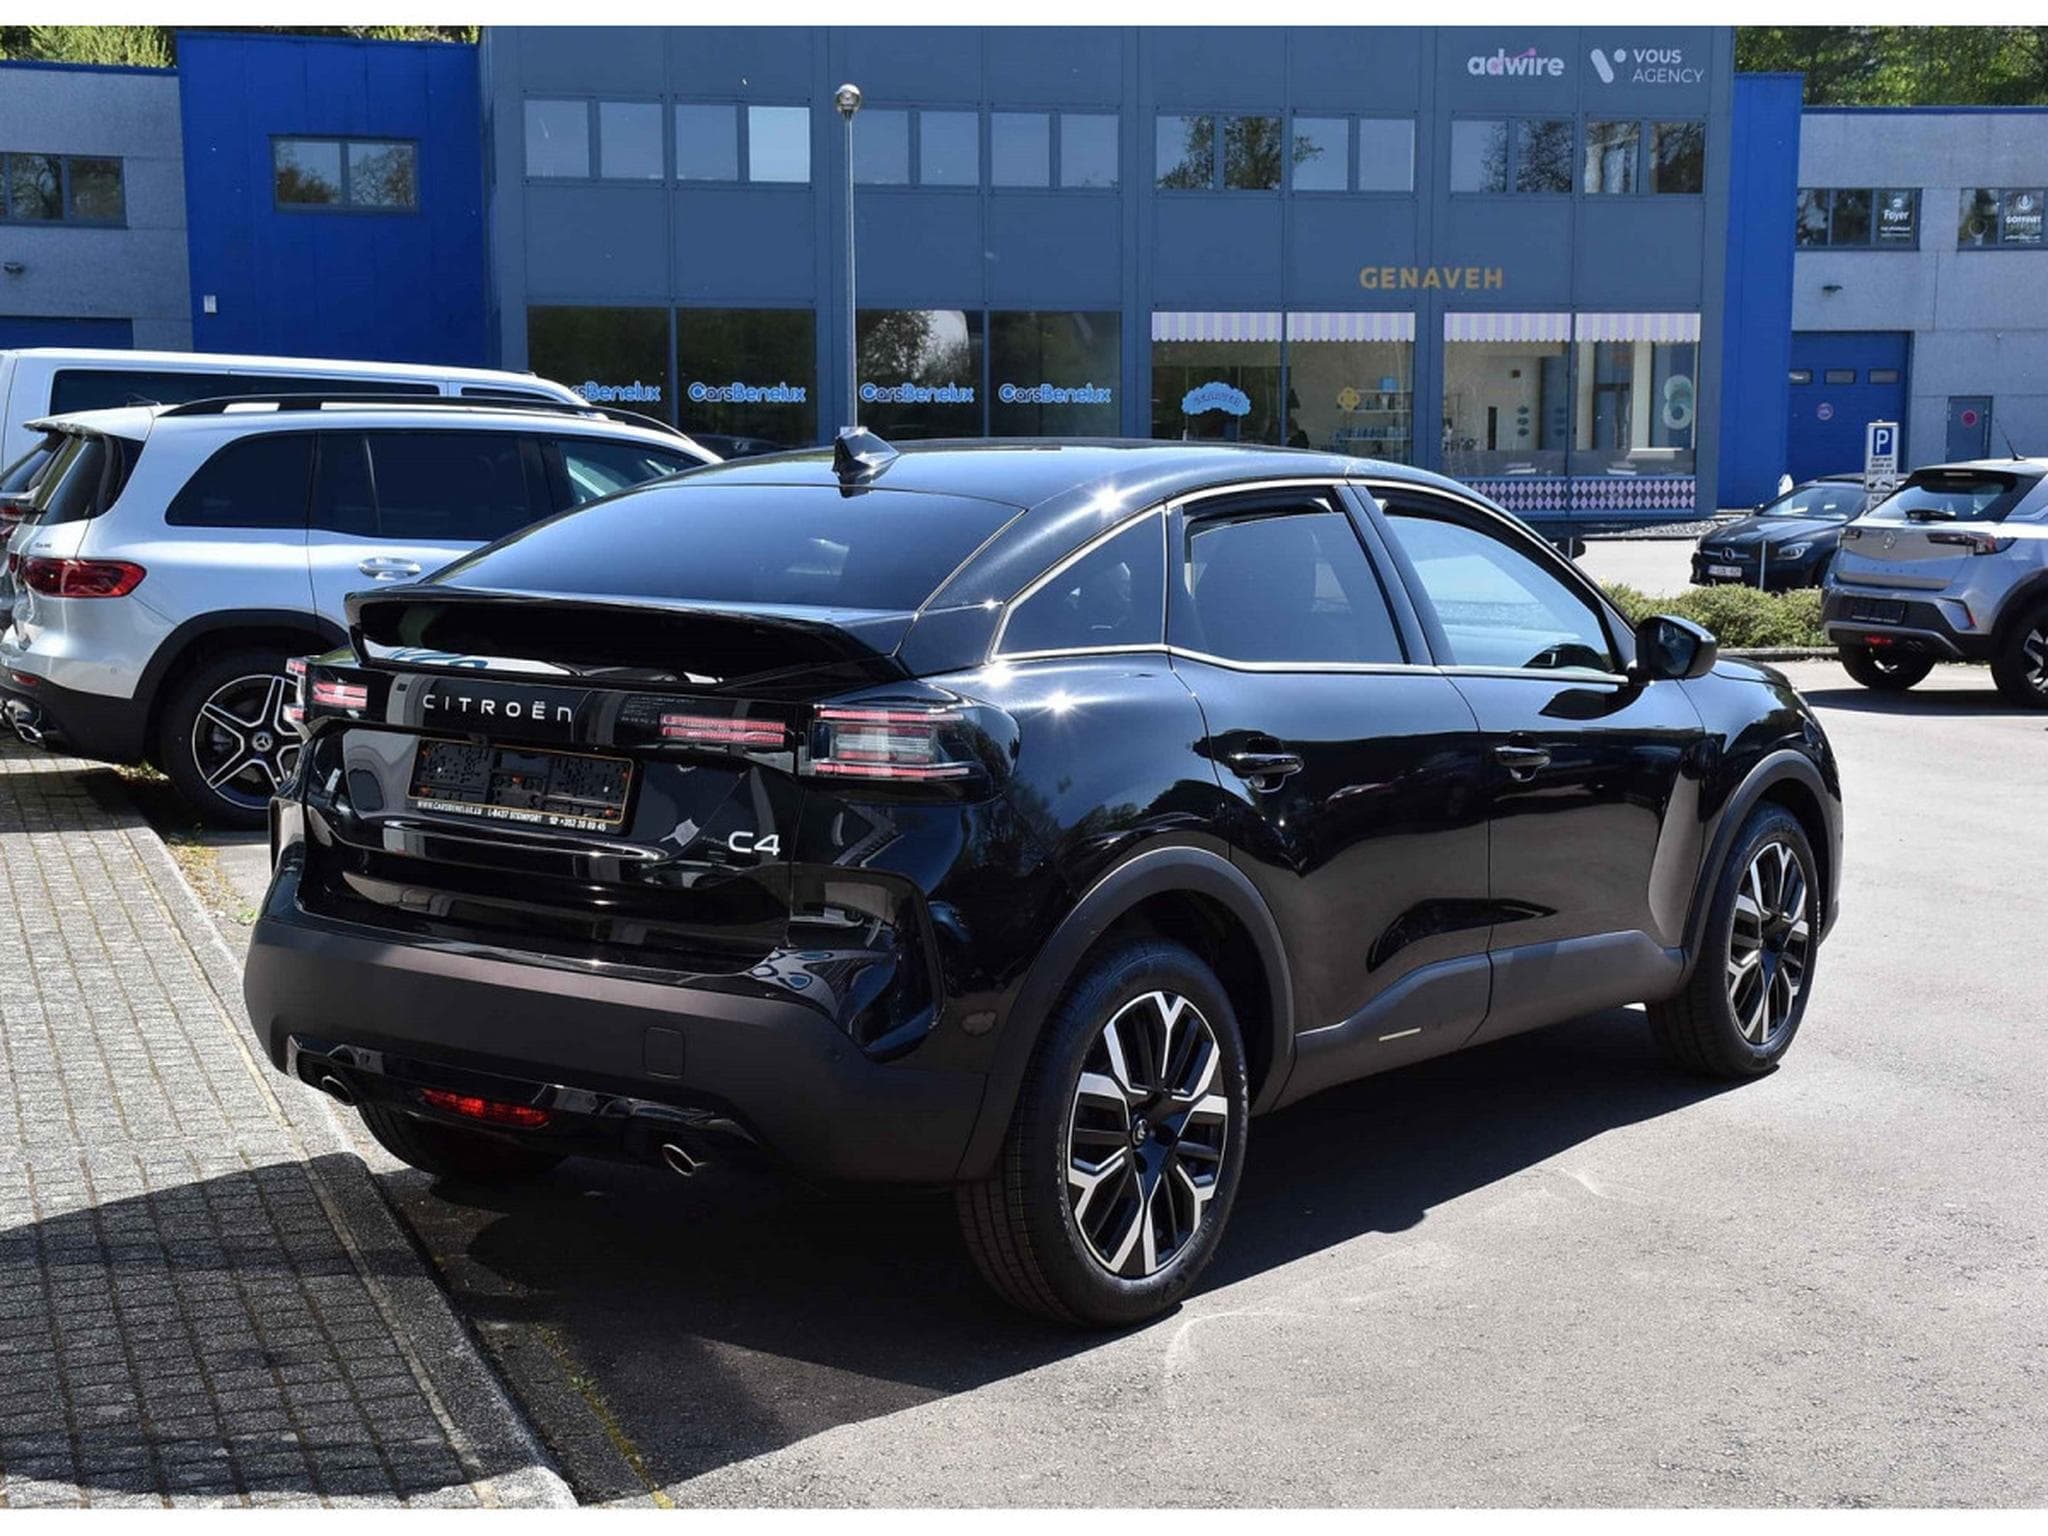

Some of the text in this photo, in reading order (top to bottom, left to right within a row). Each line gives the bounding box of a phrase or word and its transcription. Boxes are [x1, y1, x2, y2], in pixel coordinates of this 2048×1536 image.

[1467, 47, 1565, 76] adwire
[1633, 49, 1682, 64] VOUS
[1632, 68, 1705, 83] AGENCY
[1359, 266, 1504, 289] GENAVEH
[688, 381, 806, 402] CarsBenelux
[859, 381, 975, 402] CarsBenelux
[998, 381, 1112, 403] CarsBenelux
[1876, 429, 1890, 454] P
[422, 694, 573, 723] CITROËN
[728, 830, 781, 857] C4
